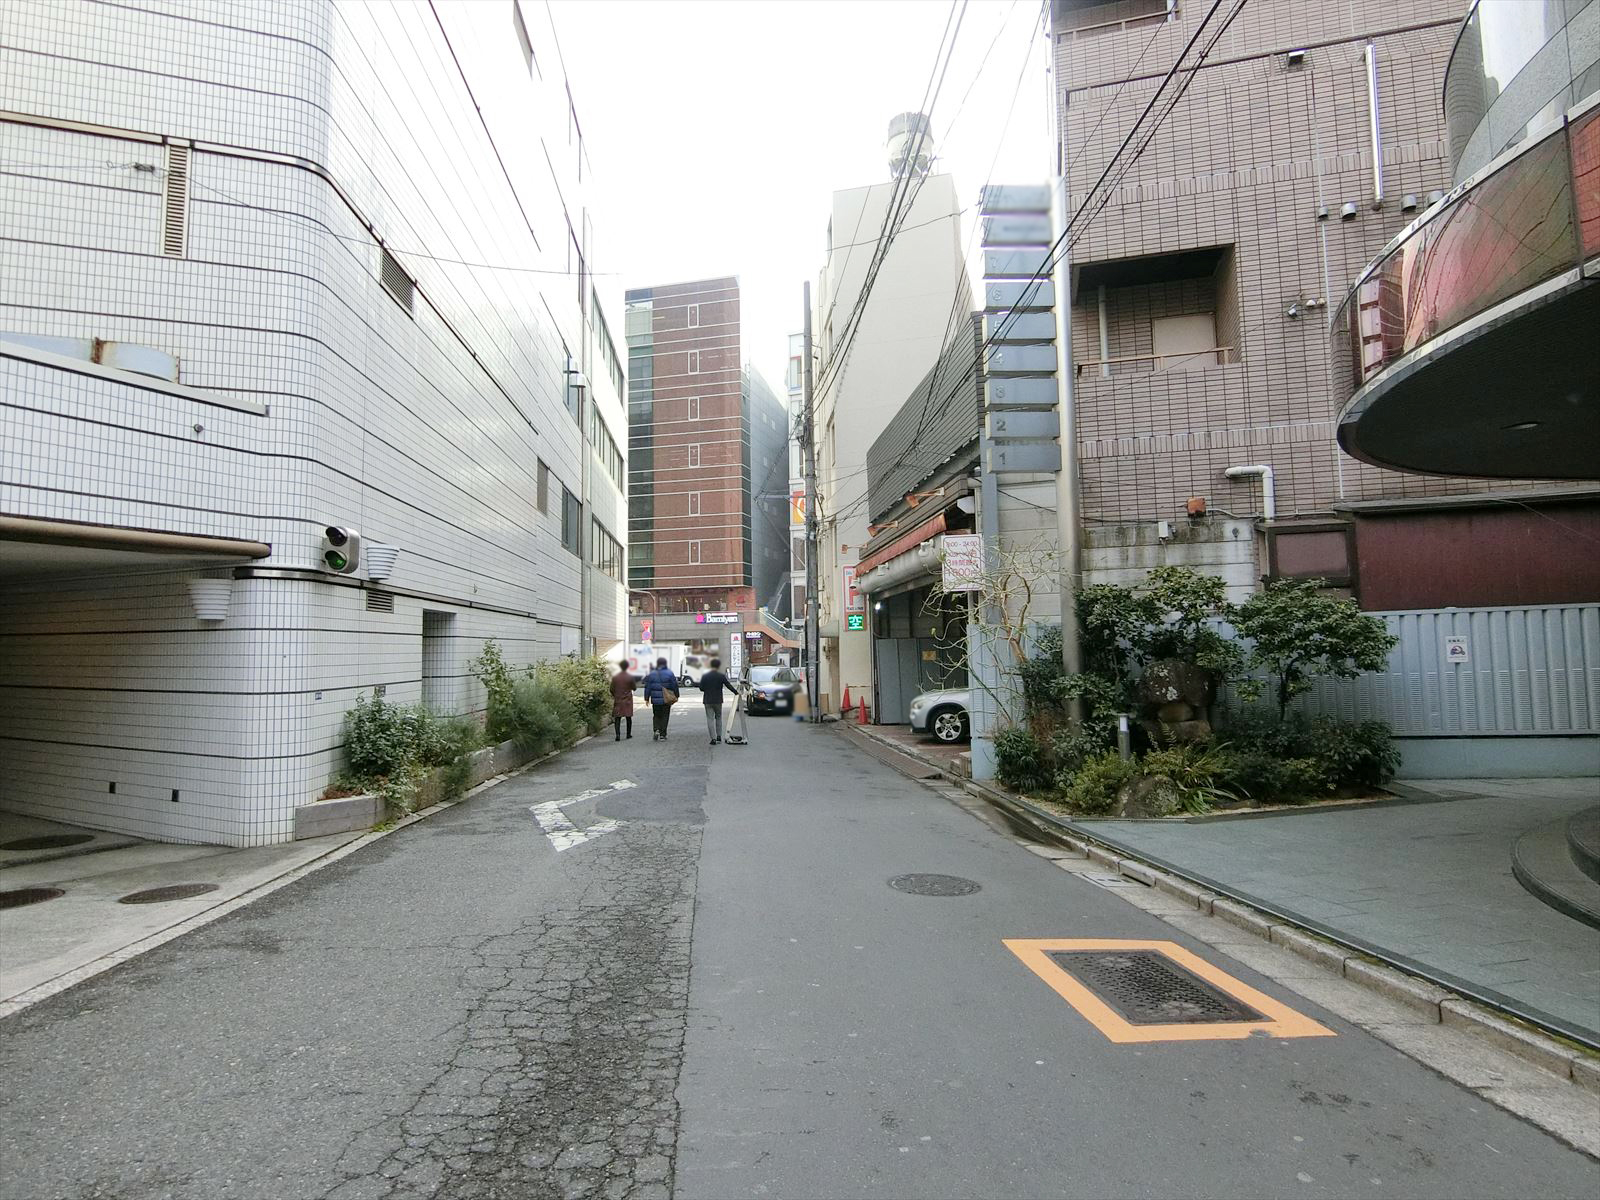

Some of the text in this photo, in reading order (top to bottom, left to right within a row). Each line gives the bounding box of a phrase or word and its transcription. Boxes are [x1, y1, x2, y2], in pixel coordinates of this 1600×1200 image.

[994, 320, 1003, 333] 5
[993, 352, 1005, 365] 4
[995, 385, 1006, 398] 3
[996, 419, 1007, 432] 2
[999, 452, 1006, 465] 1
[848, 615, 863, 629] 空
